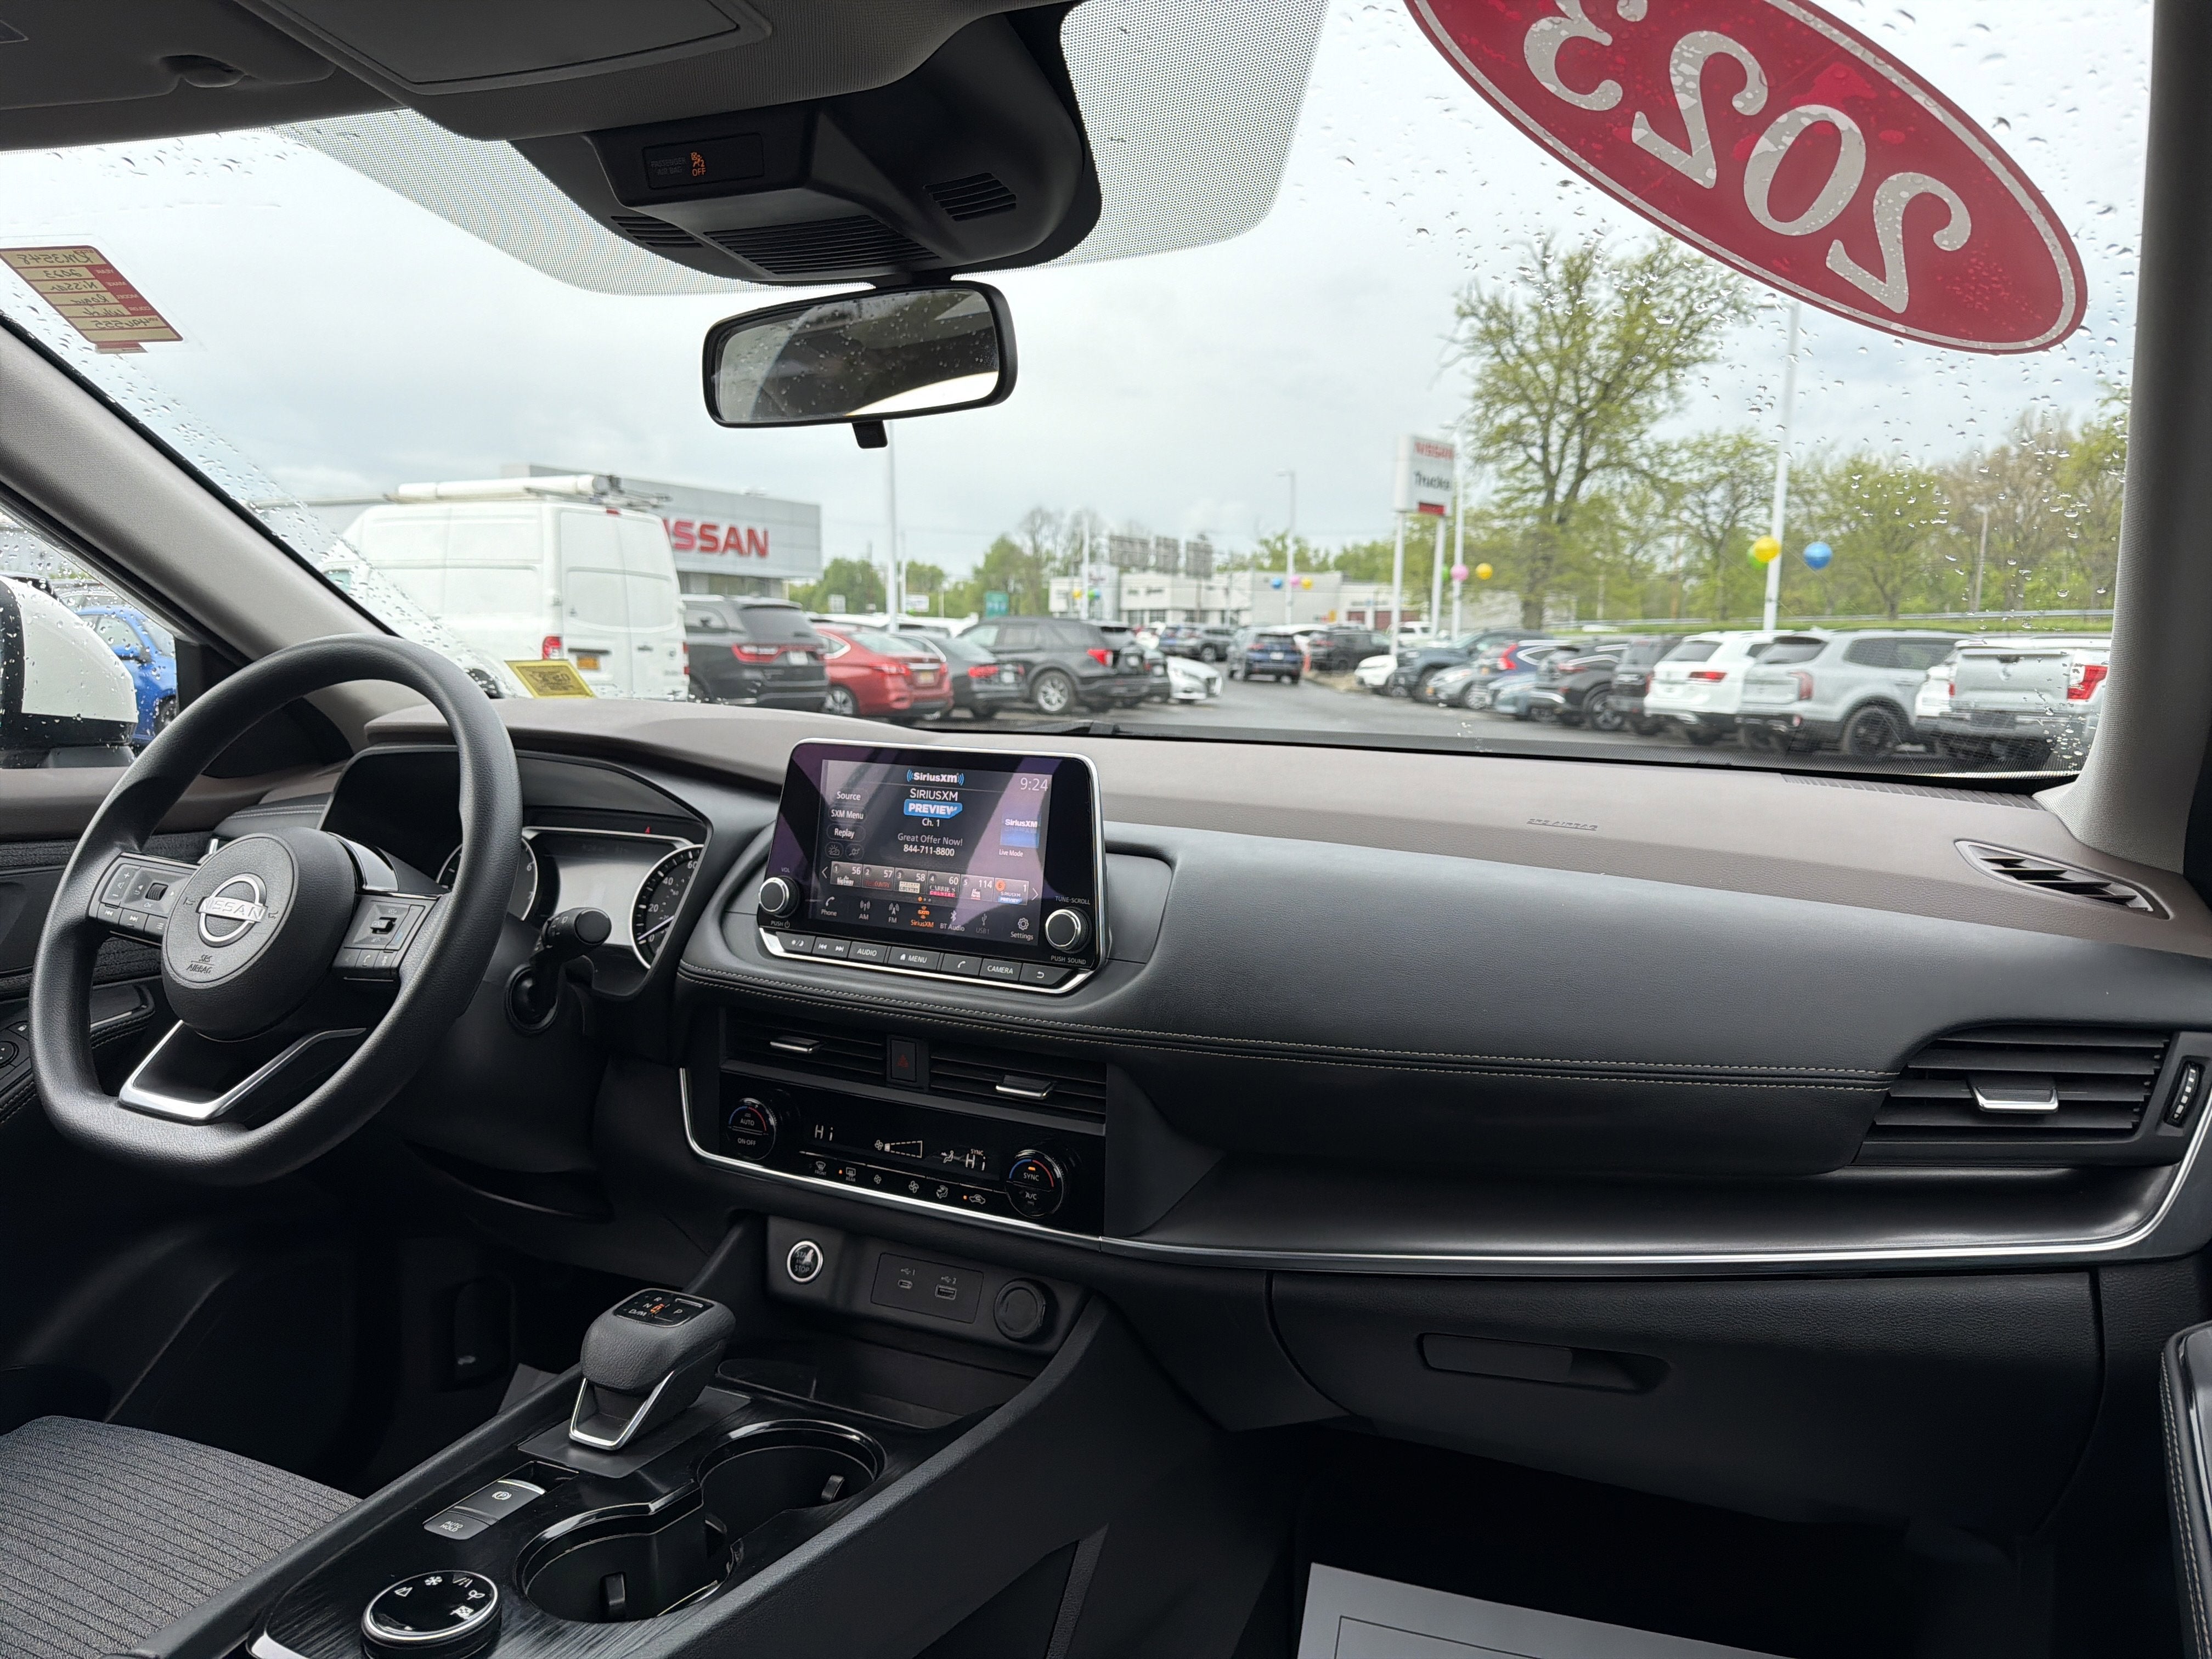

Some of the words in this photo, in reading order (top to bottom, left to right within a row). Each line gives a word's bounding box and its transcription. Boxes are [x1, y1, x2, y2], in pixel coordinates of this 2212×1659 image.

[692, 168, 706, 177] OFF
[1020, 777, 1048, 792] 9:24
[837, 791, 861, 801] Source
[910, 788, 958, 801] SIRIUSXM
[909, 803, 958, 815] PREVIEW
[831, 809, 845, 818] SXM
[847, 811, 864, 820] Menu
[922, 818, 934, 827] Ch.
[936, 819, 940, 827] 1
[1005, 819, 1038, 828] SiriusXM
[834, 828, 855, 839] Replay
[898, 832, 918, 843] Great
[920, 834, 941, 844] Offer
[943, 837, 963, 846] Now!
[903, 844, 955, 856] 844-711-8800
[527, 864, 532, 872] 6
[687, 861, 698, 869] 60
[851, 866, 861, 875] 56
[883, 870, 893, 878] 57
[663, 877, 674, 885] 40
[916, 873, 926, 882] 58
[949, 876, 959, 885] 60
[979, 879, 992, 889] 114
[1023, 884, 1027, 892] 1
[201, 899, 264, 920] NISSAN
[648, 904, 659, 912] 20
[911, 919, 934, 928] SiriusXM
[948, 924, 965, 932] Audio
[648, 934, 654, 943] 0
[1011, 931, 1034, 941] Settings
[908, 955, 927, 963] MENU
[1068, 957, 1086, 965] SOUND
[987, 965, 1013, 974] CAMERA
[1023, 1173, 1040, 1181] SYNC
[1025, 1192, 1037, 1200] A/C
[796, 1251, 813, 1260] STA
[794, 1265, 810, 1273] STOP
[439, 1524, 459, 1532] HOLD
